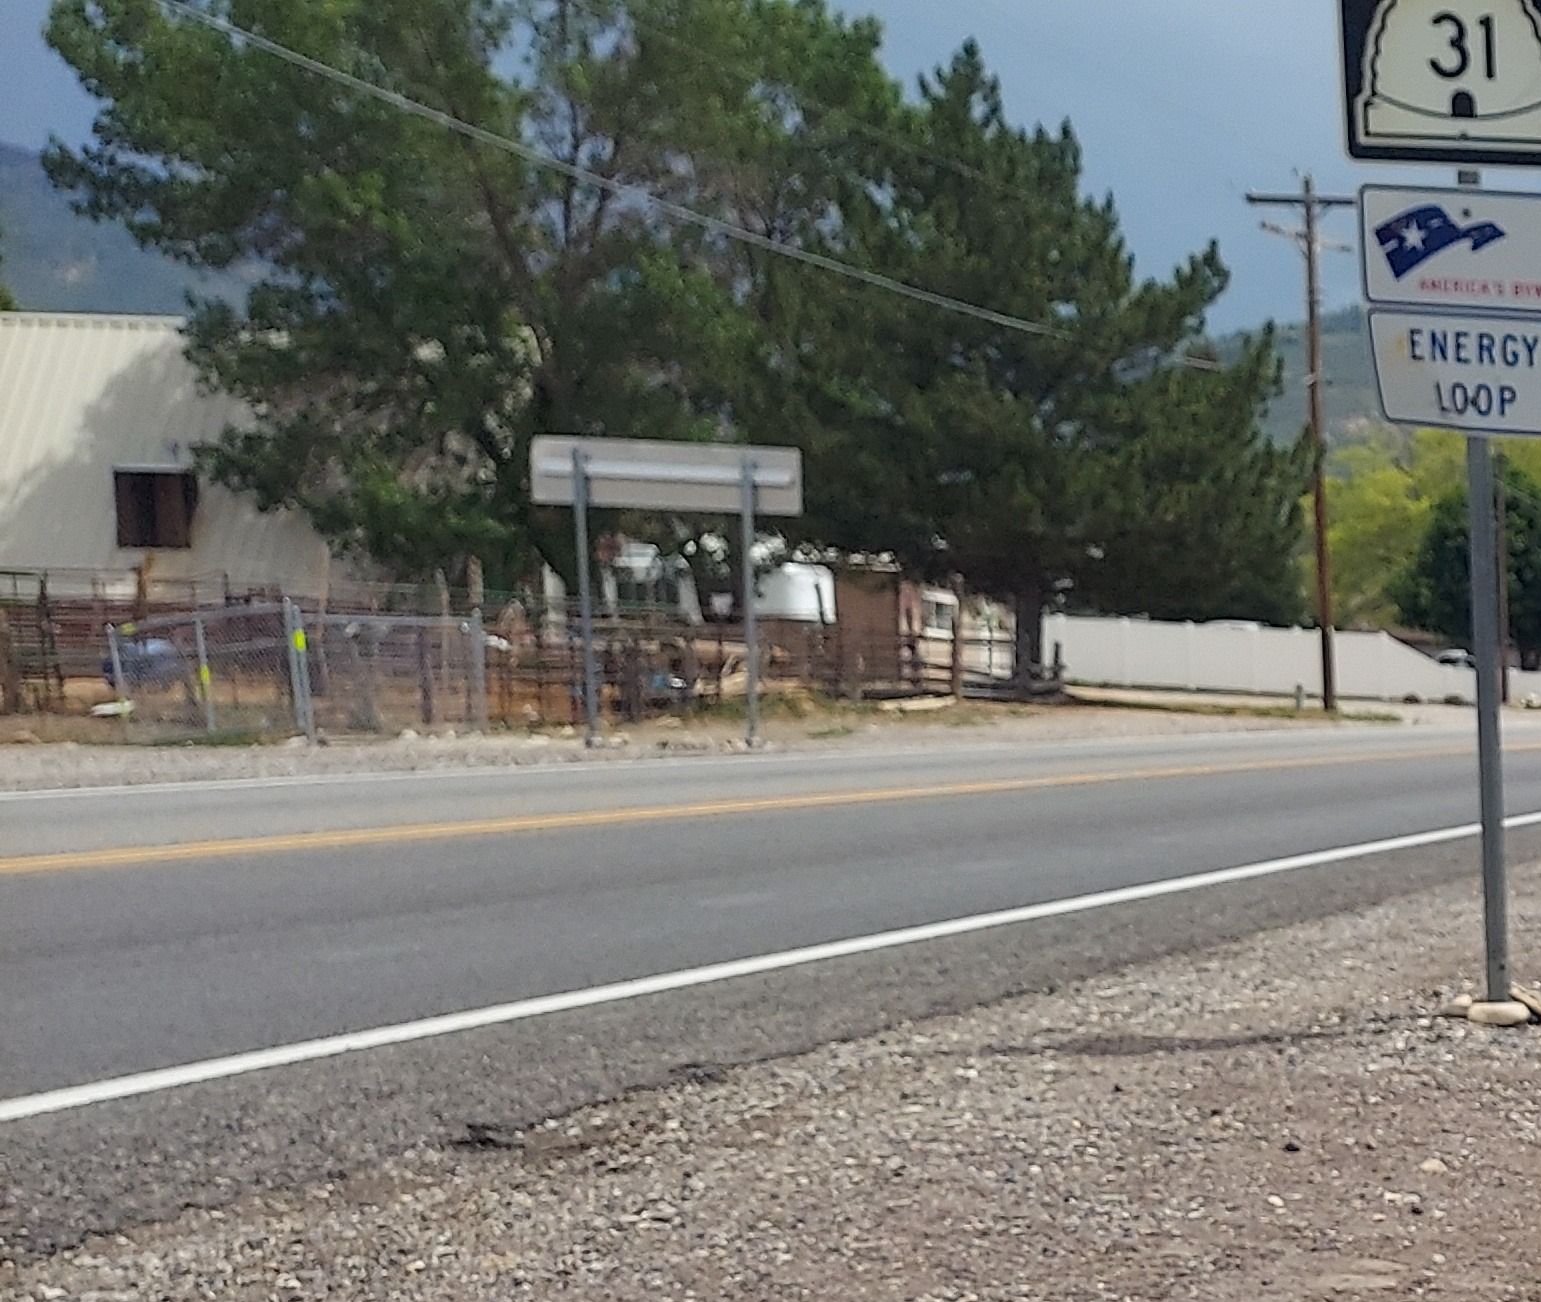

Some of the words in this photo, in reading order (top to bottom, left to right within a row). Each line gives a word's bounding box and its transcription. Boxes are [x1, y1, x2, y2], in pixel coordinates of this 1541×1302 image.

[1429, 12, 1494, 78] 31
[1408, 328, 1539, 367] ENERGY
[1435, 381, 1517, 417] LOOP
